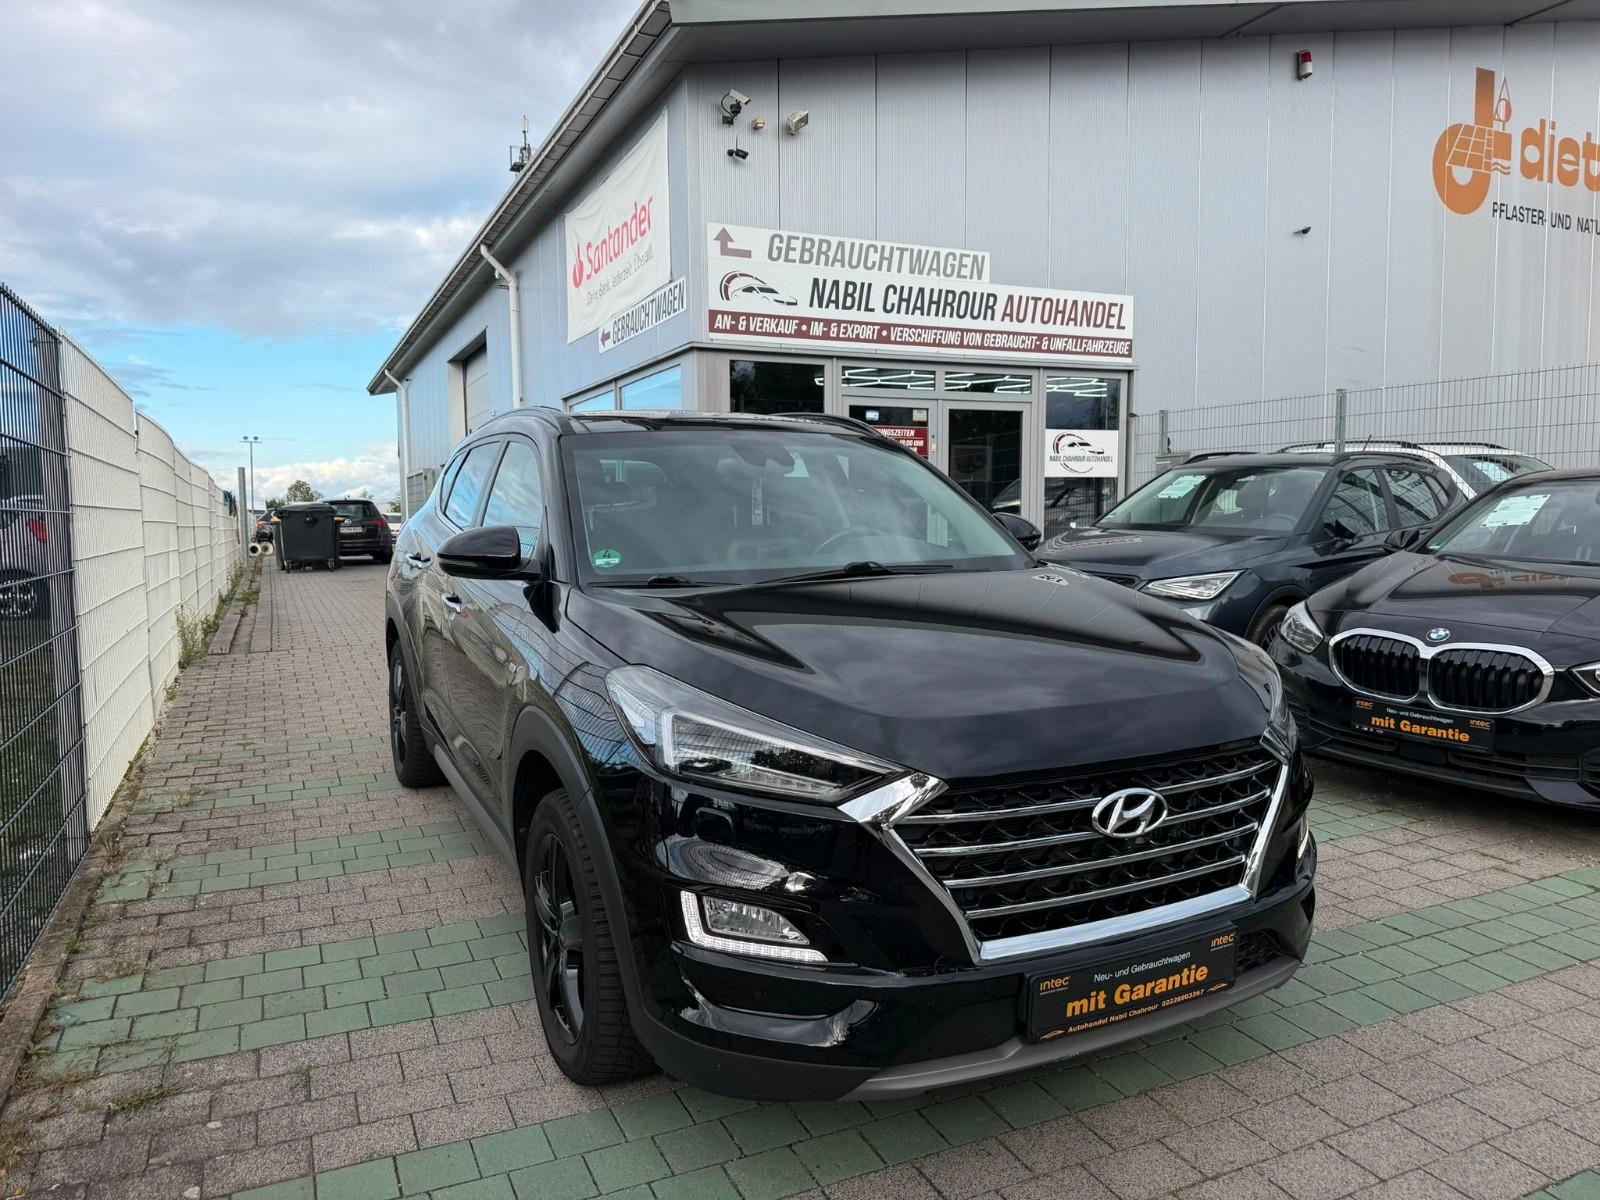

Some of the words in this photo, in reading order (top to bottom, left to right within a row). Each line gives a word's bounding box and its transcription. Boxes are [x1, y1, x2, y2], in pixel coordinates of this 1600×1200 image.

[586, 196, 653, 280] Santander
[1492, 202, 1547, 226] PFLASTER-
[1550, 212, 1572, 230] UND
[767, 233, 986, 281] GEBRAUCHTWAGEN
[612, 280, 685, 345] GEBRAUCHTWAGEN
[808, 277, 875, 313] NABIL
[882, 284, 998, 321] CHAHROUR
[1001, 294, 1126, 330] AUTOHANDEL
[714, 313, 736, 329] AN-
[738, 316, 746, 331] &
[749, 316, 800, 335] VERKAUF
[809, 321, 828, 336] IM-
[830, 323, 838, 337] &
[839, 323, 881, 340] EXPORT
[890, 327, 961, 345] VERSCHIFFUNG
[963, 331, 983, 346] VON
[983, 333, 1040, 350] GEBRAUCHT-
[1042, 337, 1049, 350] &
[1050, 337, 1131, 355] UNFALLFAHRZEUGE
[1371, 716, 1396, 729] mit
[1400, 719, 1470, 742] Garantie
[1094, 973, 1113, 983] Neu-
[1115, 967, 1129, 979] und
[1131, 952, 1191, 974] Gebrauchtwagen
[1066, 990, 1107, 1018] mit
[1114, 963, 1209, 1005] Garantie
[1068, 1017, 1109, 1033] Autohandel
[1109, 1012, 1128, 1023] Nabil
[1128, 1004, 1159, 1017] Chahrour
